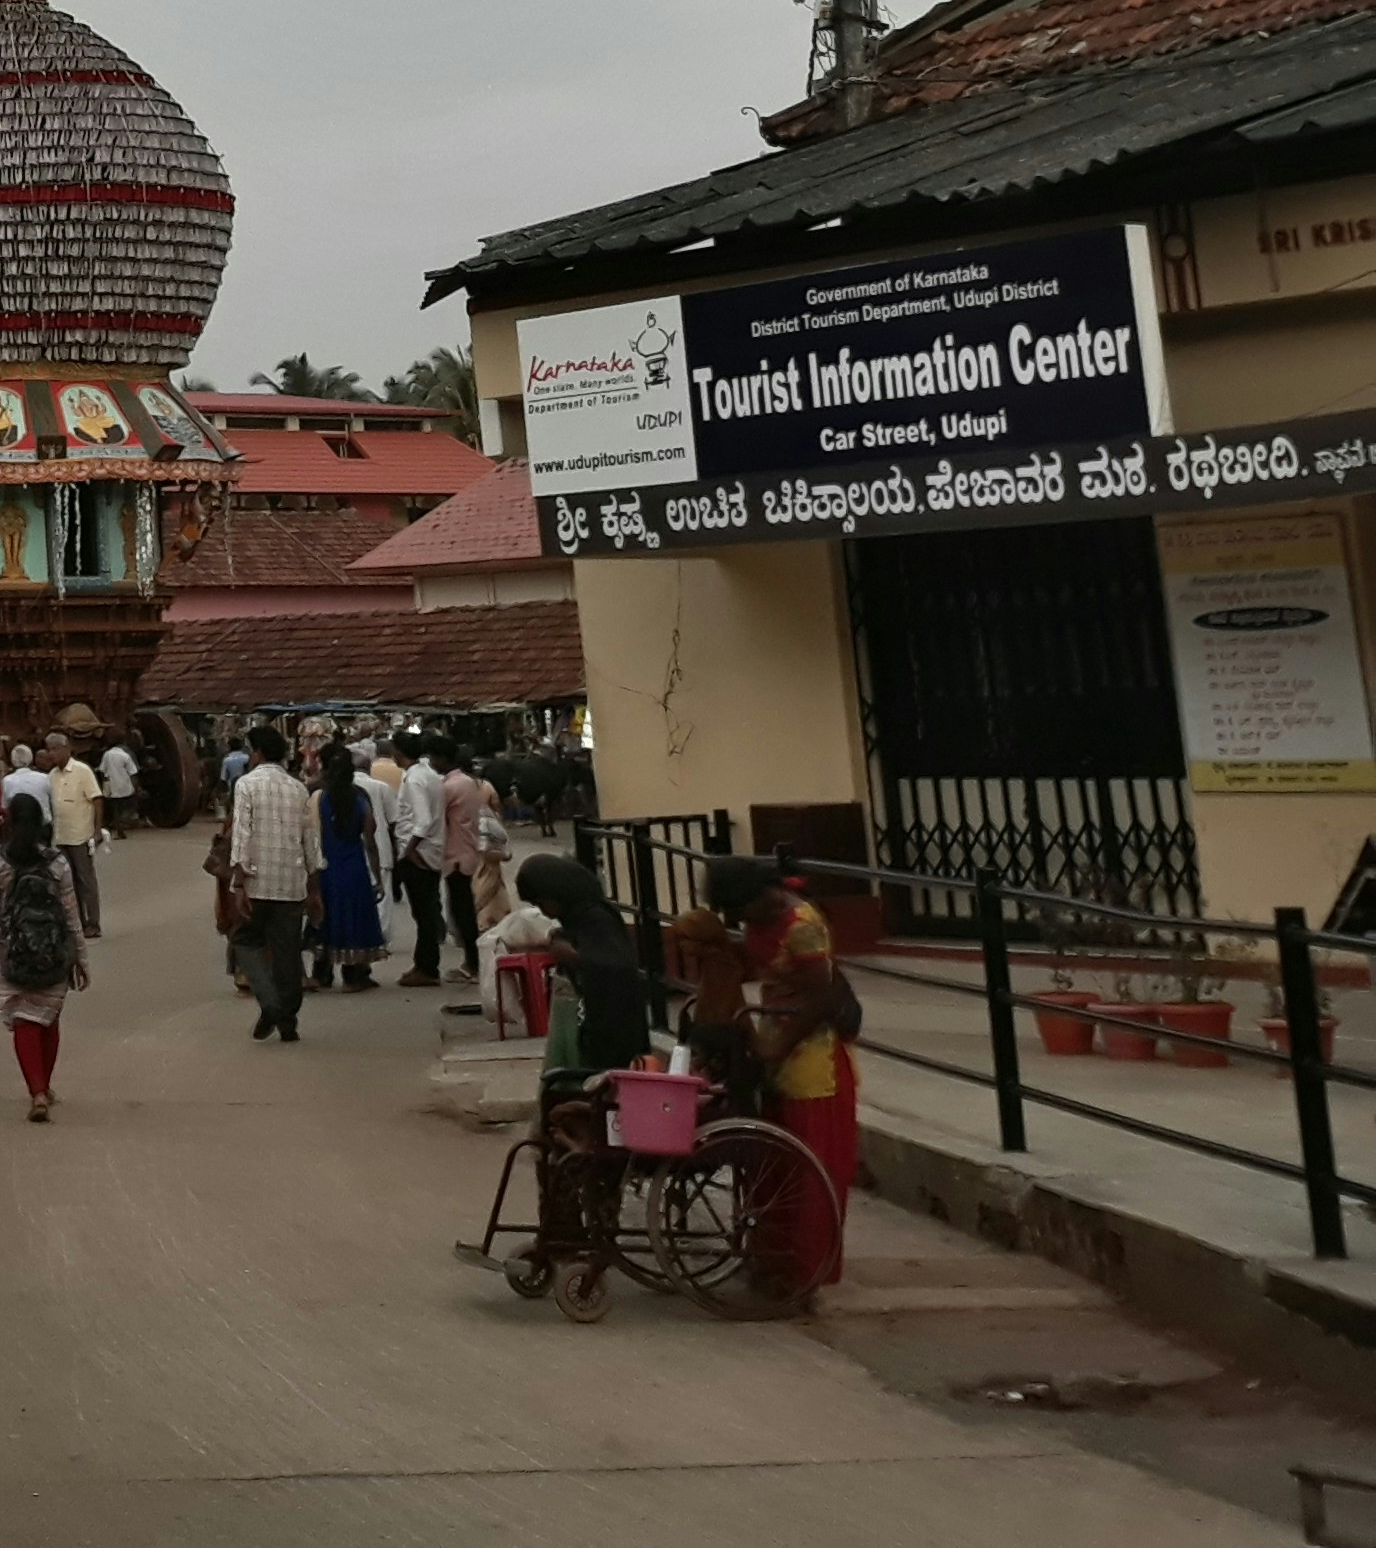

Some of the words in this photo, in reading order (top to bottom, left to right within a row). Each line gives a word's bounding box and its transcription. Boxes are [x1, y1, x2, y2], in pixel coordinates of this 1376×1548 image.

[1311, 218, 1376, 248] KRIS
[806, 279, 891, 305] Government
[895, 274, 910, 292] of
[912, 264, 989, 289] Karnataka
[750, 317, 800, 338] District
[802, 308, 859, 330] Tourism
[862, 295, 950, 323] Department,
[953, 286, 999, 309] Udupi
[1002, 277, 1059, 302] District
[527, 350, 635, 393] Karnataka
[533, 385, 550, 395] One
[579, 379, 603, 390] Many
[692, 356, 803, 422] Tourist
[808, 332, 1002, 409] Information
[1008, 316, 1131, 386] Center
[528, 399, 584, 414] Department
[587, 396, 597, 407] of
[601, 392, 640, 405] Tourism
[636, 410, 682, 431] UDUPI
[819, 427, 856, 452] Car
[861, 416, 936, 449] Street,
[941, 408, 1007, 441] Udupi
[534, 446, 685, 475] www.udupitourism.com
[556, 495, 590, 555] ಶ್ರೀ
[600, 491, 660, 550] ಕೃಷ್ಣ
[666, 481, 748, 532] ಉಚಿತ
